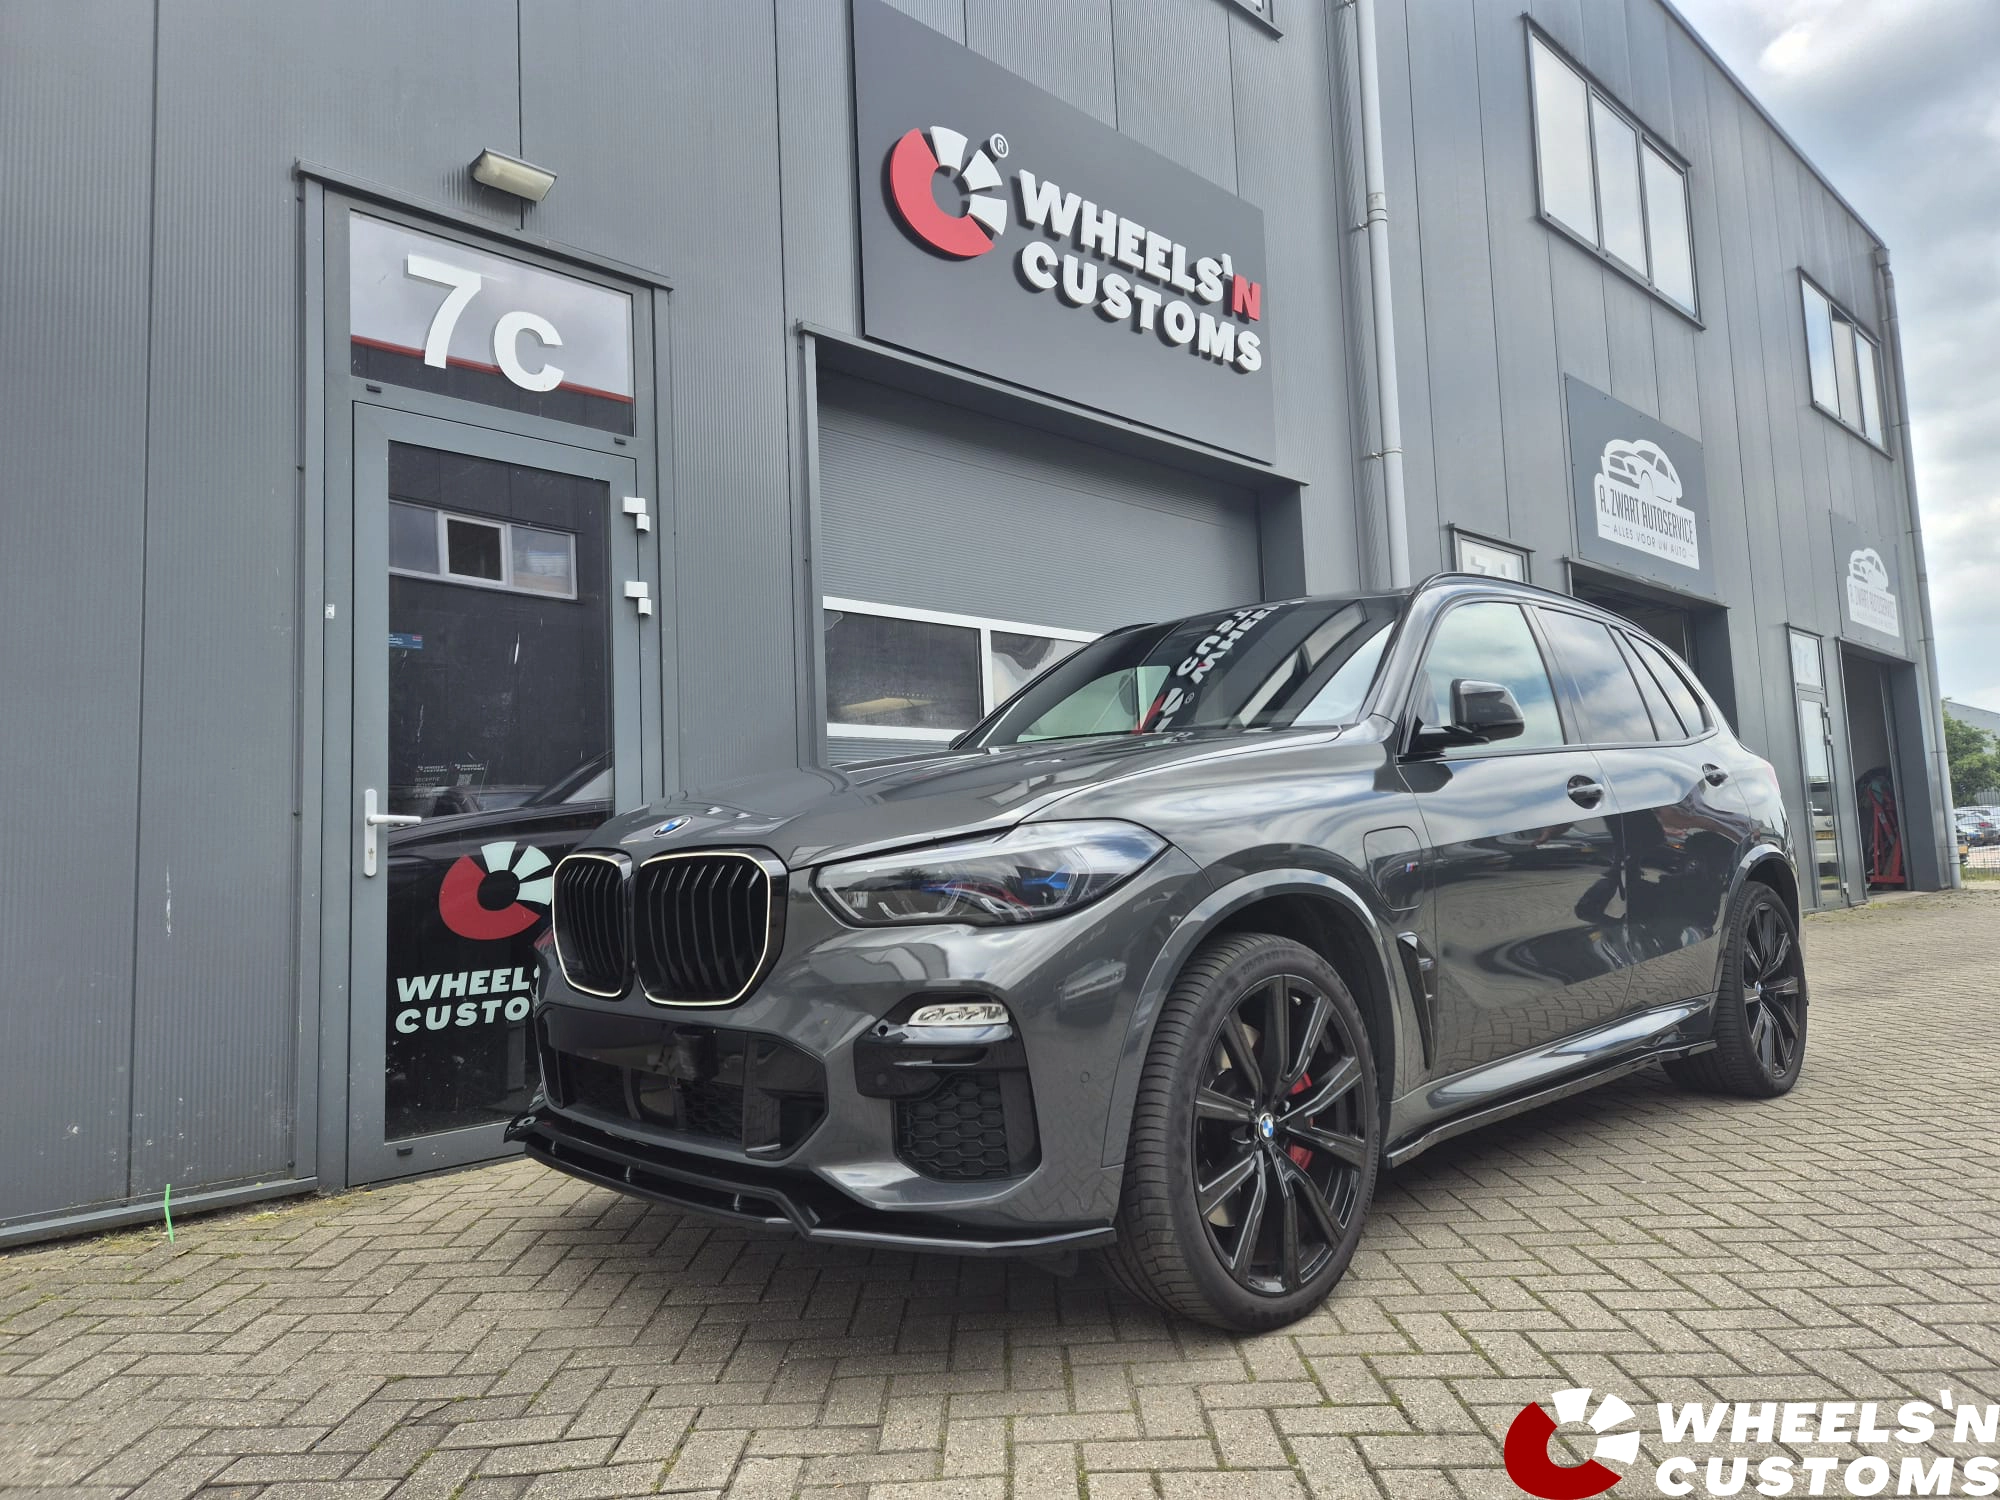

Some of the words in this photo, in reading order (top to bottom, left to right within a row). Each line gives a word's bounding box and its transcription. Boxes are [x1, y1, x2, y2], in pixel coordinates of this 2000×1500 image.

[1019, 169, 1262, 321] WHEELS'N
[1021, 241, 1262, 372] CUSTOMS
[1599, 484, 1610, 514] A.
[1610, 489, 1640, 525] ZWART
[1641, 501, 1694, 545] AUTOSERVICE
[1613, 524, 1633, 540] ALLES
[1636, 533, 1656, 547] VOOR
[1670, 544, 1687, 558] AUTO
[395, 996, 530, 1034] CUSTO
